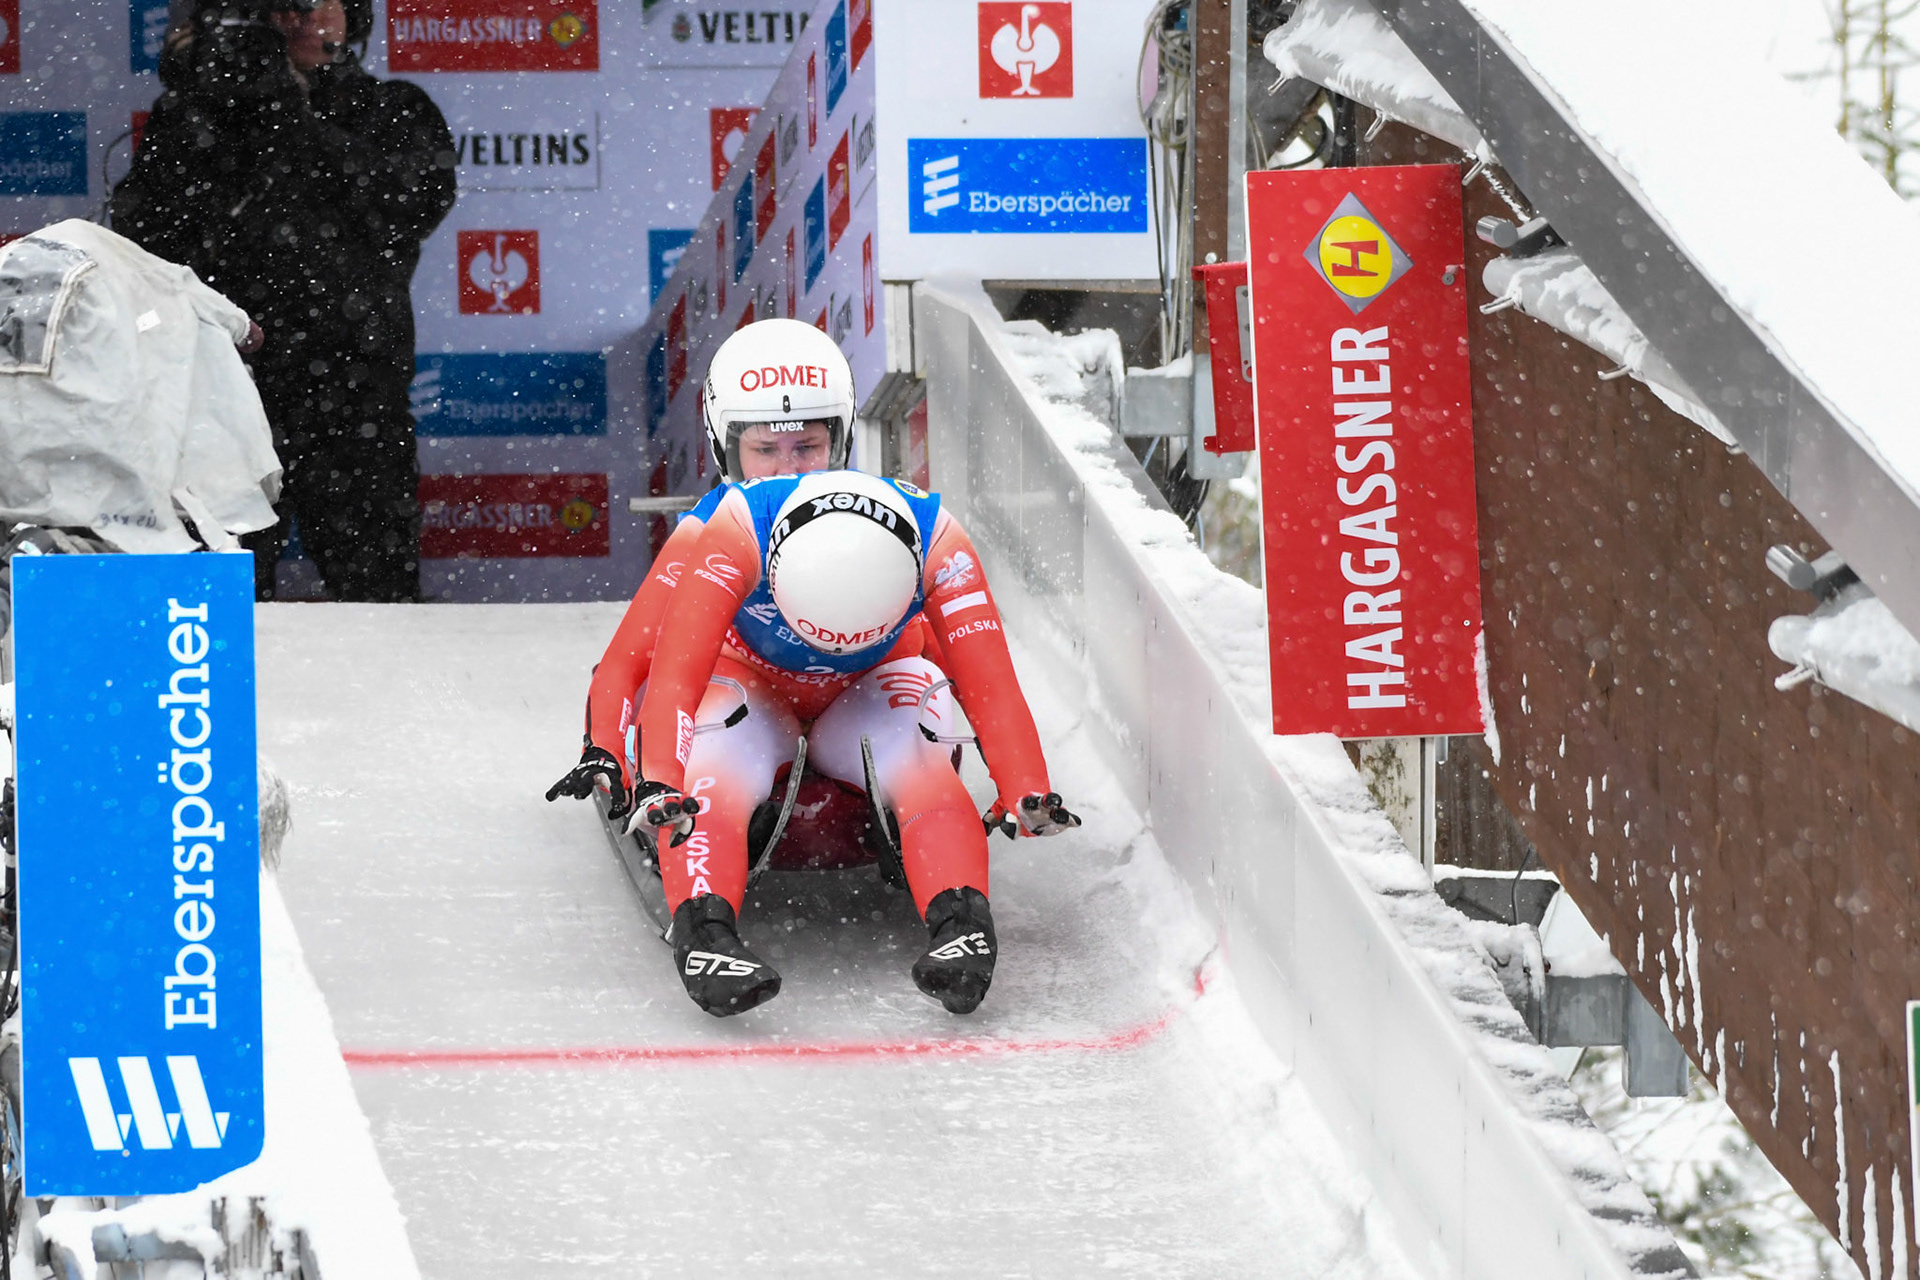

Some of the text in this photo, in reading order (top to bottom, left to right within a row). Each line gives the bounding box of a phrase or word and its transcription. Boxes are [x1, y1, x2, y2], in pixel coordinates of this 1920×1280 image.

[394, 17, 542, 43] HARGASSNER
[968, 190, 1132, 217] Eberspächer
[740, 365, 828, 392] ODMET
[769, 421, 804, 432] uvex
[422, 504, 551, 529] ARGASSNER
[810, 492, 897, 530] uvex
[1330, 326, 1406, 710] HARGASSNER
[797, 618, 888, 645] ODMET
[947, 619, 1000, 644] POLSKA
[158, 597, 226, 1031] Eberspächer
[686, 777, 717, 897] POSKA
[684, 950, 763, 976] GTS
